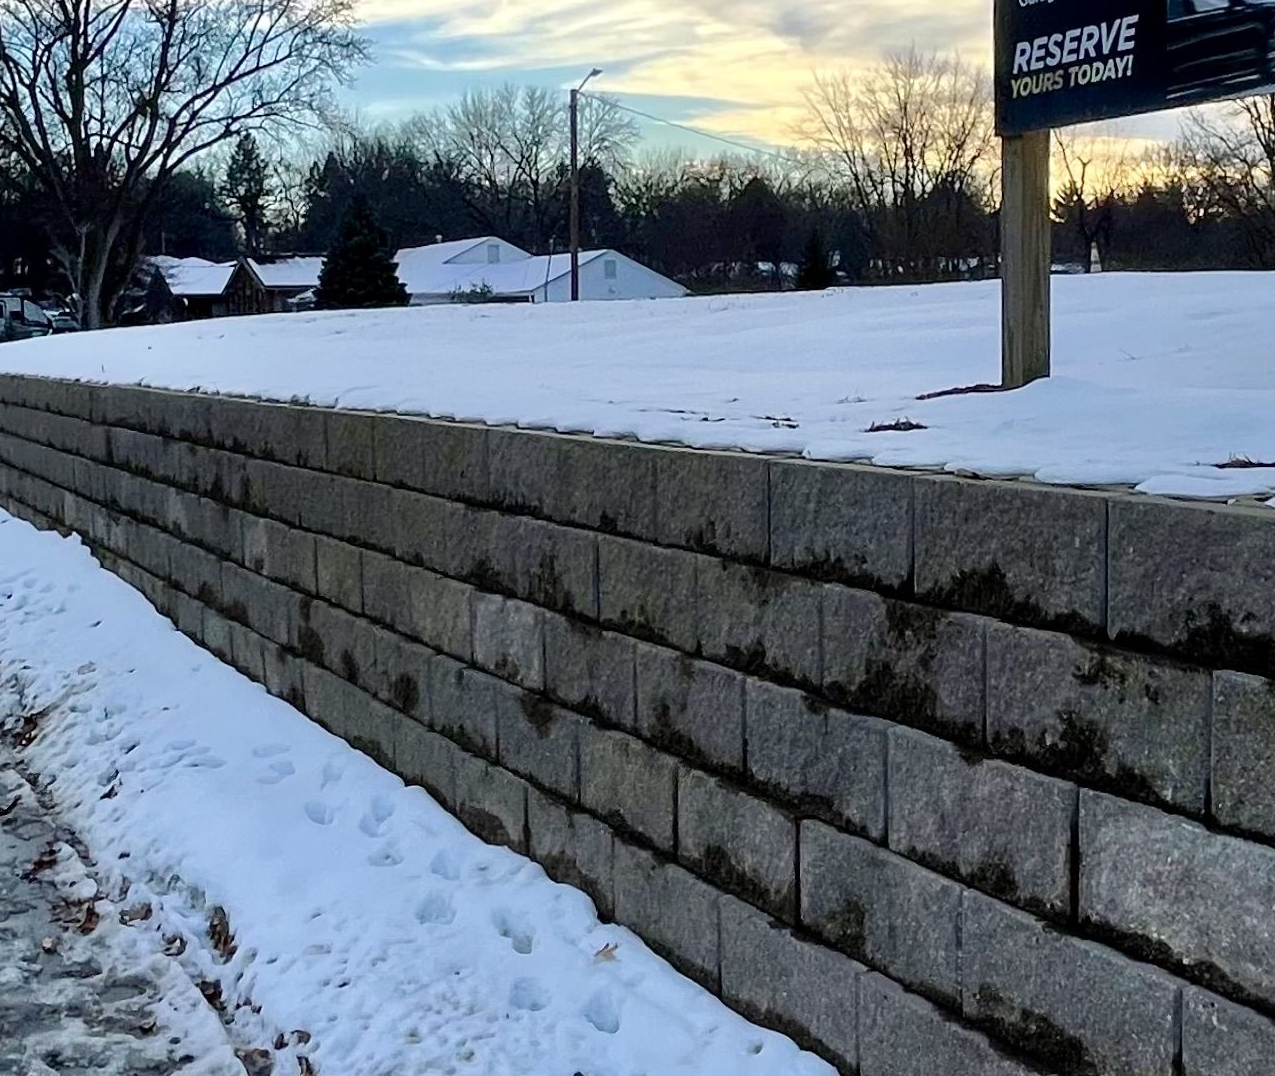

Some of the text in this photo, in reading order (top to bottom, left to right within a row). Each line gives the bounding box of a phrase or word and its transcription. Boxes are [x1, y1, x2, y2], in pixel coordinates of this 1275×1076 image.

[1012, 14, 1139, 75] RESERVE
[1010, 54, 1134, 99] YOURS TODAY!
